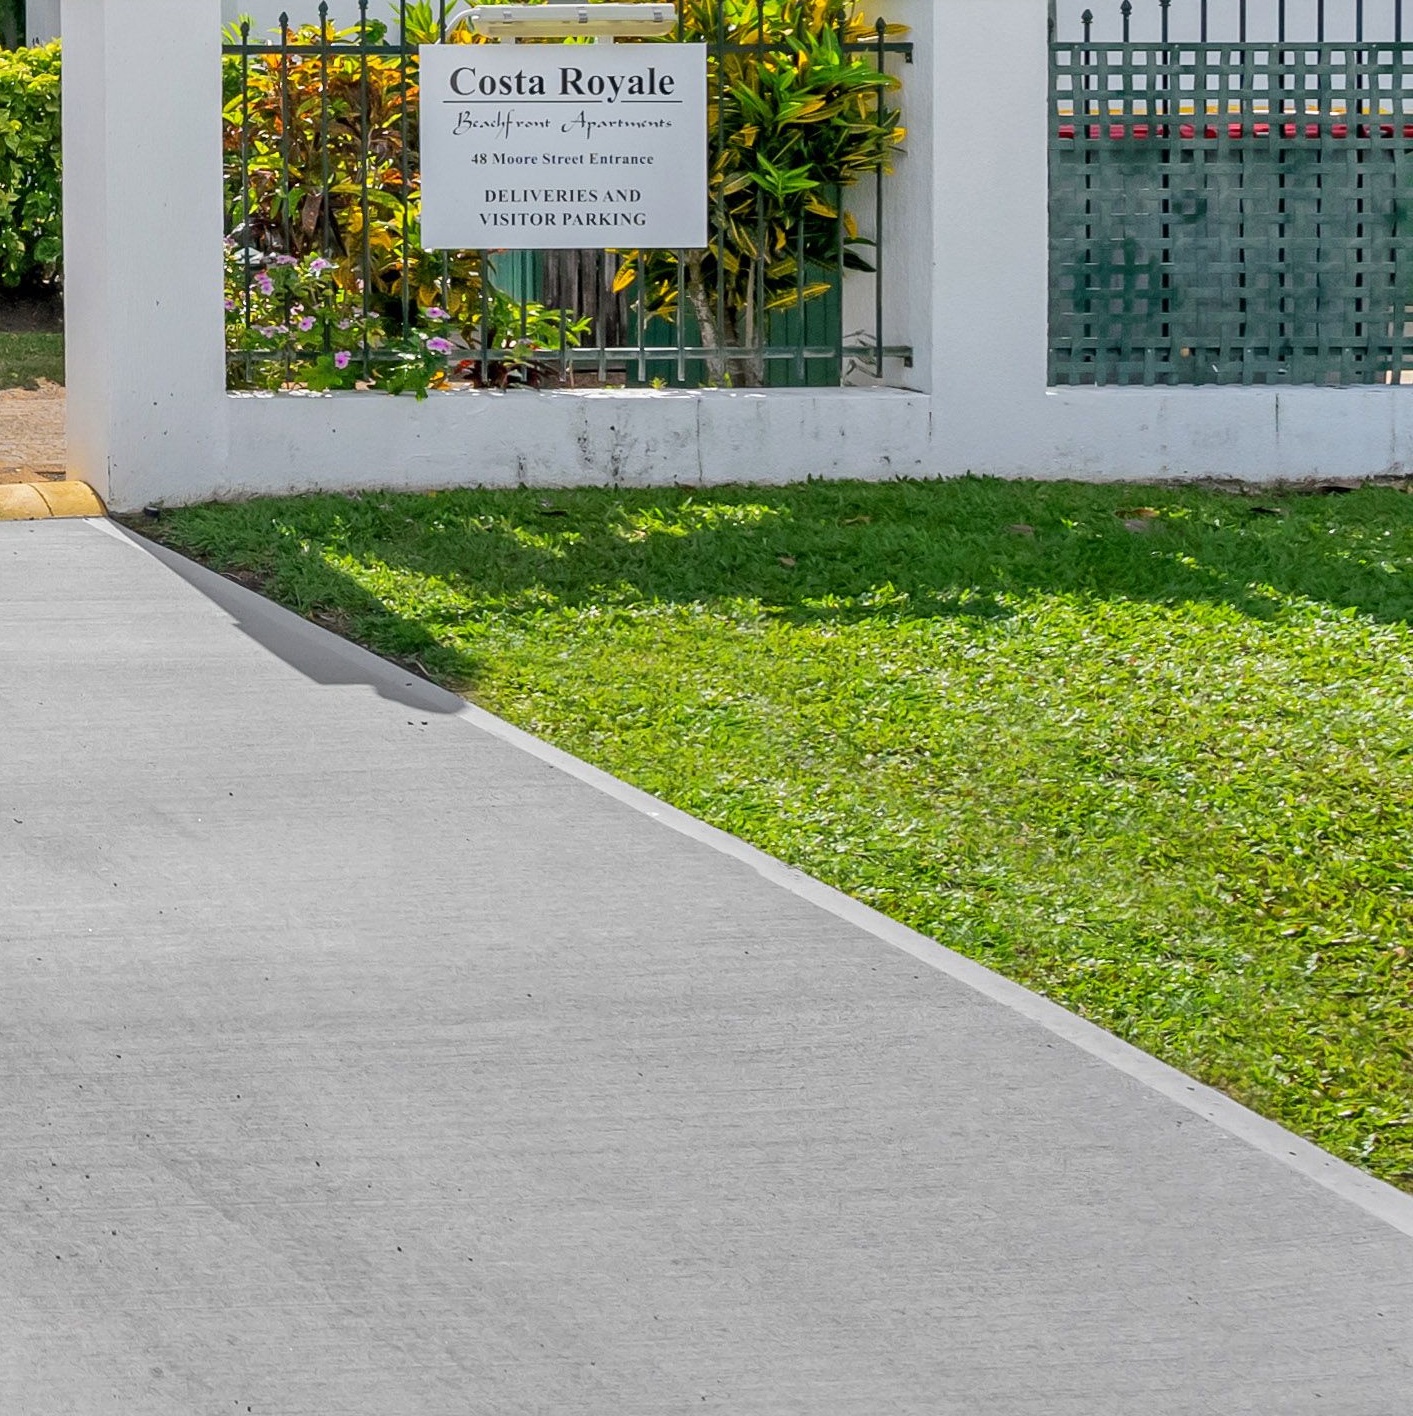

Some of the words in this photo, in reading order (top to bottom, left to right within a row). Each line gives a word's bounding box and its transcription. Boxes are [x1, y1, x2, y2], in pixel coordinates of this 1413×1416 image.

[449, 66, 547, 96] Costa
[557, 66, 675, 103] Royale
[452, 108, 551, 140] Beachfront
[560, 109, 673, 140] Apartments
[470, 152, 488, 165] 48
[492, 152, 539, 165] Moore
[541, 152, 584, 165] Street
[589, 152, 655, 165] Entrance
[484, 188, 599, 203] DELIVERIES
[602, 188, 642, 203] AND
[478, 212, 557, 227] VISITOR
[562, 212, 647, 227] PARKING
